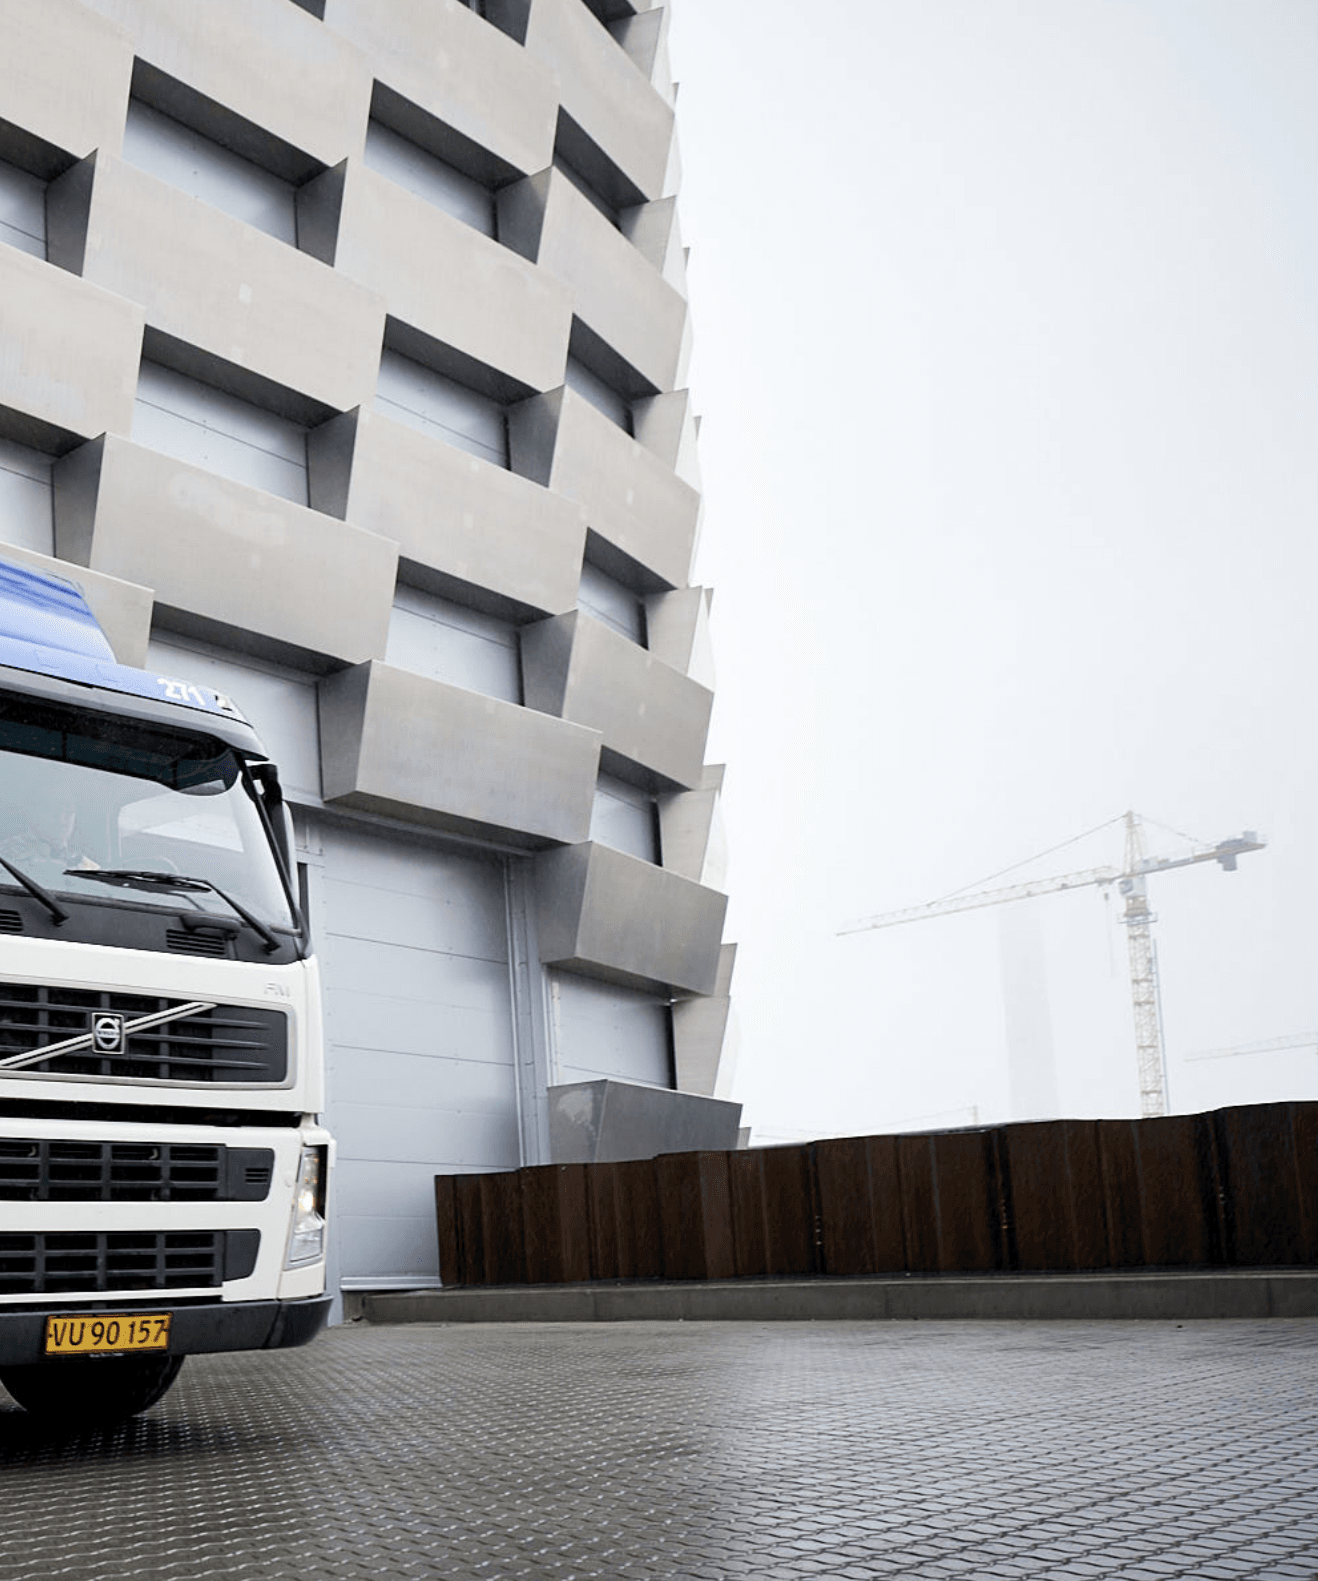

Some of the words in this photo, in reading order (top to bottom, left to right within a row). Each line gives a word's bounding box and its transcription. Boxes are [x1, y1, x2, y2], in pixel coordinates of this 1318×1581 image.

[156, 678, 206, 706] 271
[53, 1321, 86, 1347] VU
[91, 1320, 120, 1346] 90
[128, 1319, 166, 1345] 157
